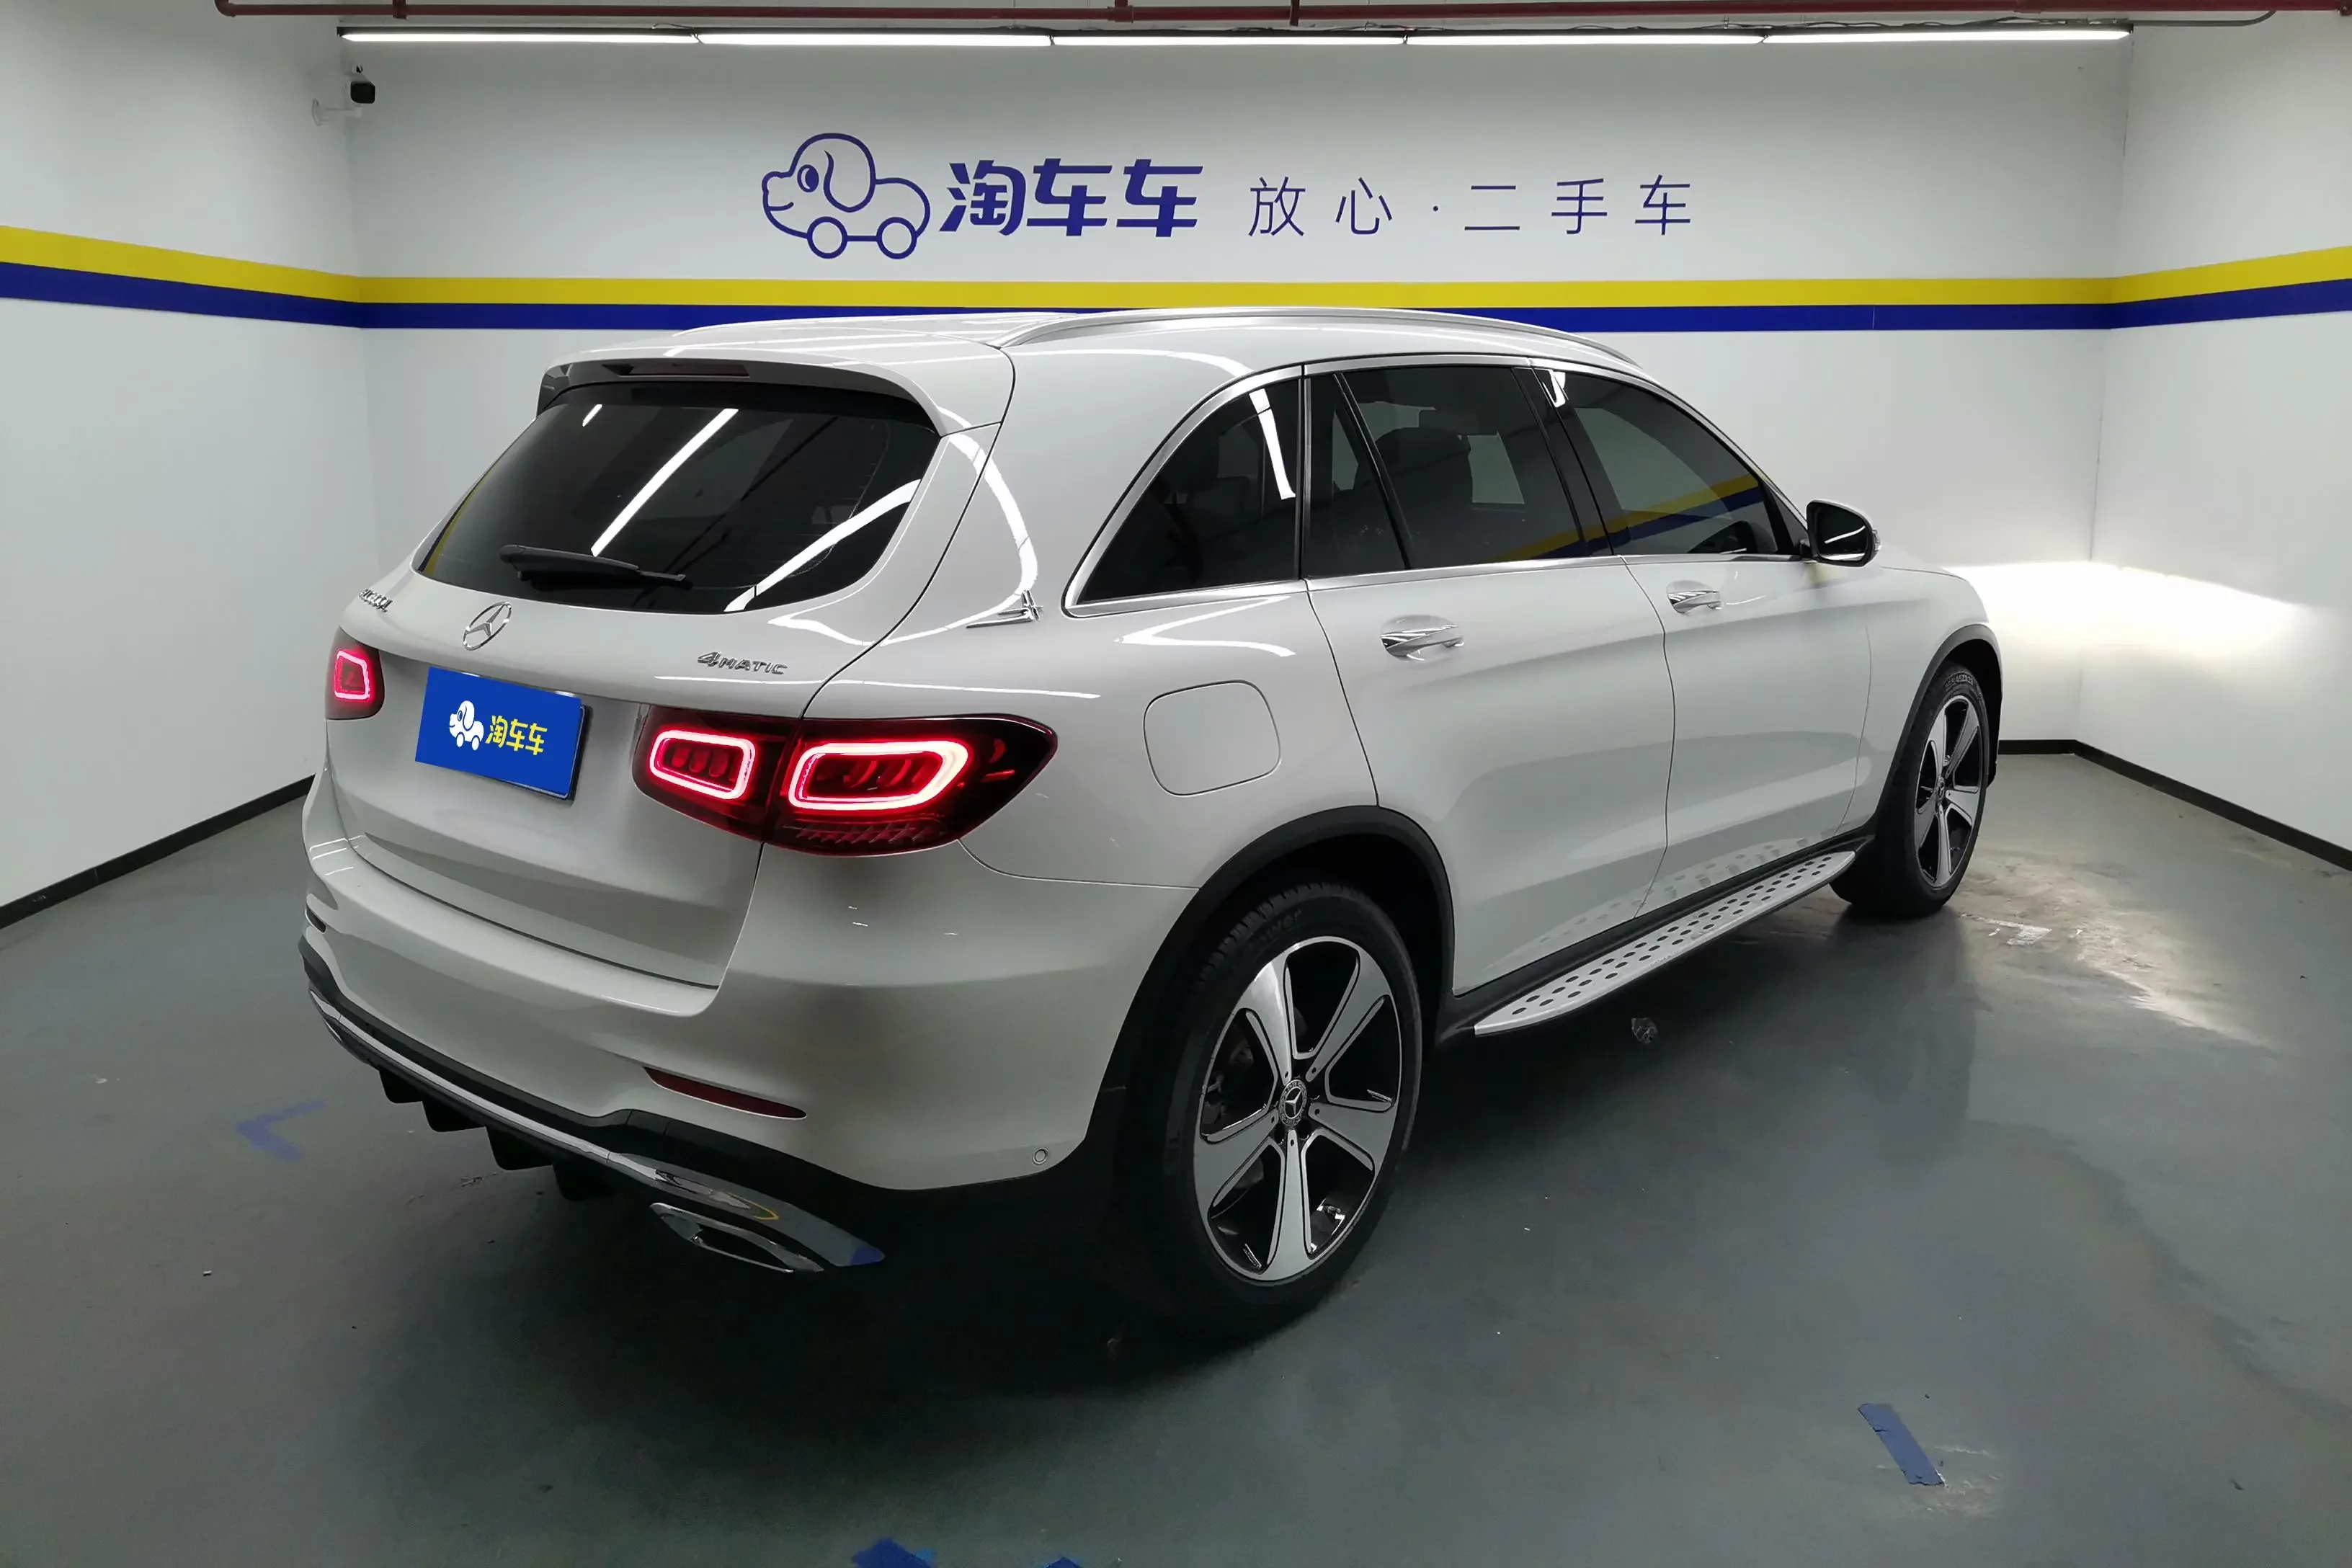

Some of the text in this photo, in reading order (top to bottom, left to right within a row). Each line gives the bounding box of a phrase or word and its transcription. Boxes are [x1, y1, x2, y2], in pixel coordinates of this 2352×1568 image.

[939, 158, 1203, 237] 淘车车
[698, 651, 788, 675] 4MATIC
